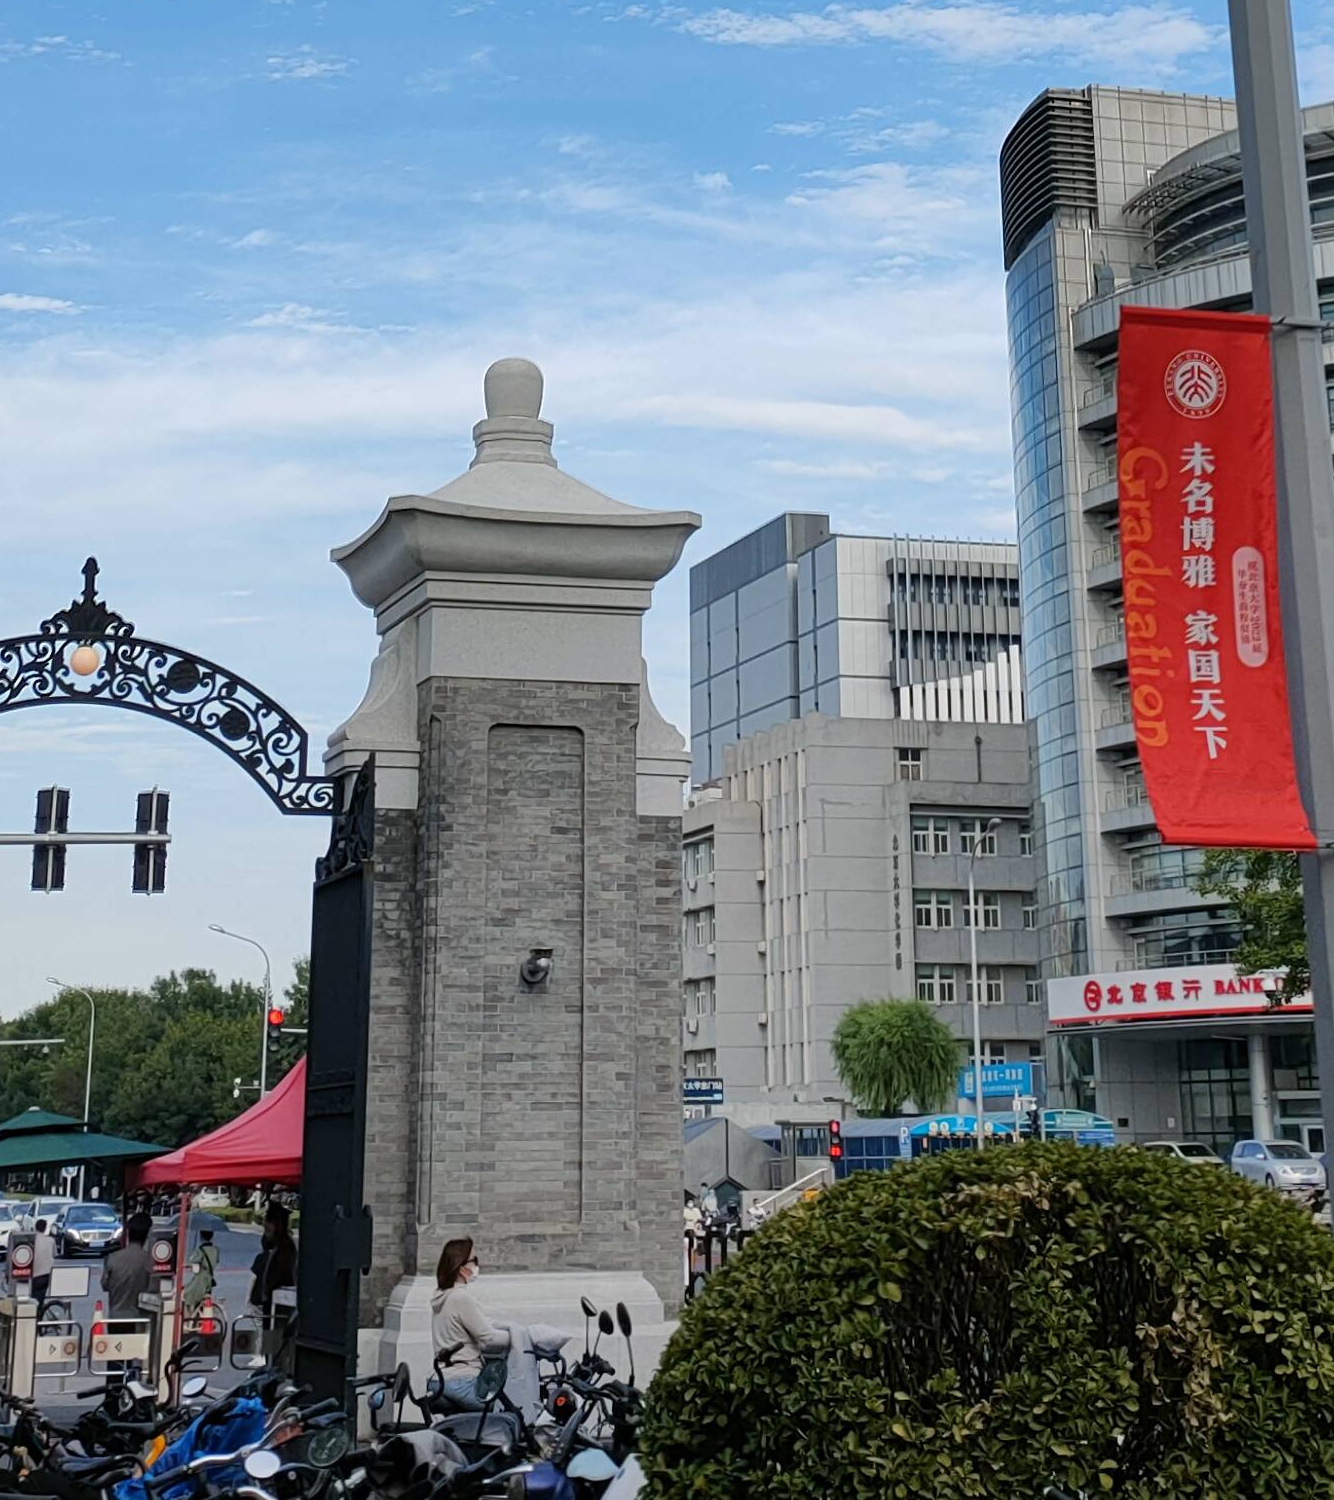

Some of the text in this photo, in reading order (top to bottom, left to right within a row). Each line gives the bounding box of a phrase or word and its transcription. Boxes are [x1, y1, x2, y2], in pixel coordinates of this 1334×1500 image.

[1119, 446, 1175, 747] Graduation
[1179, 441, 1228, 759] 未名博雅 家国天下
[1106, 979, 1202, 1005] 北京银行
[1214, 977, 1266, 995] BANK
